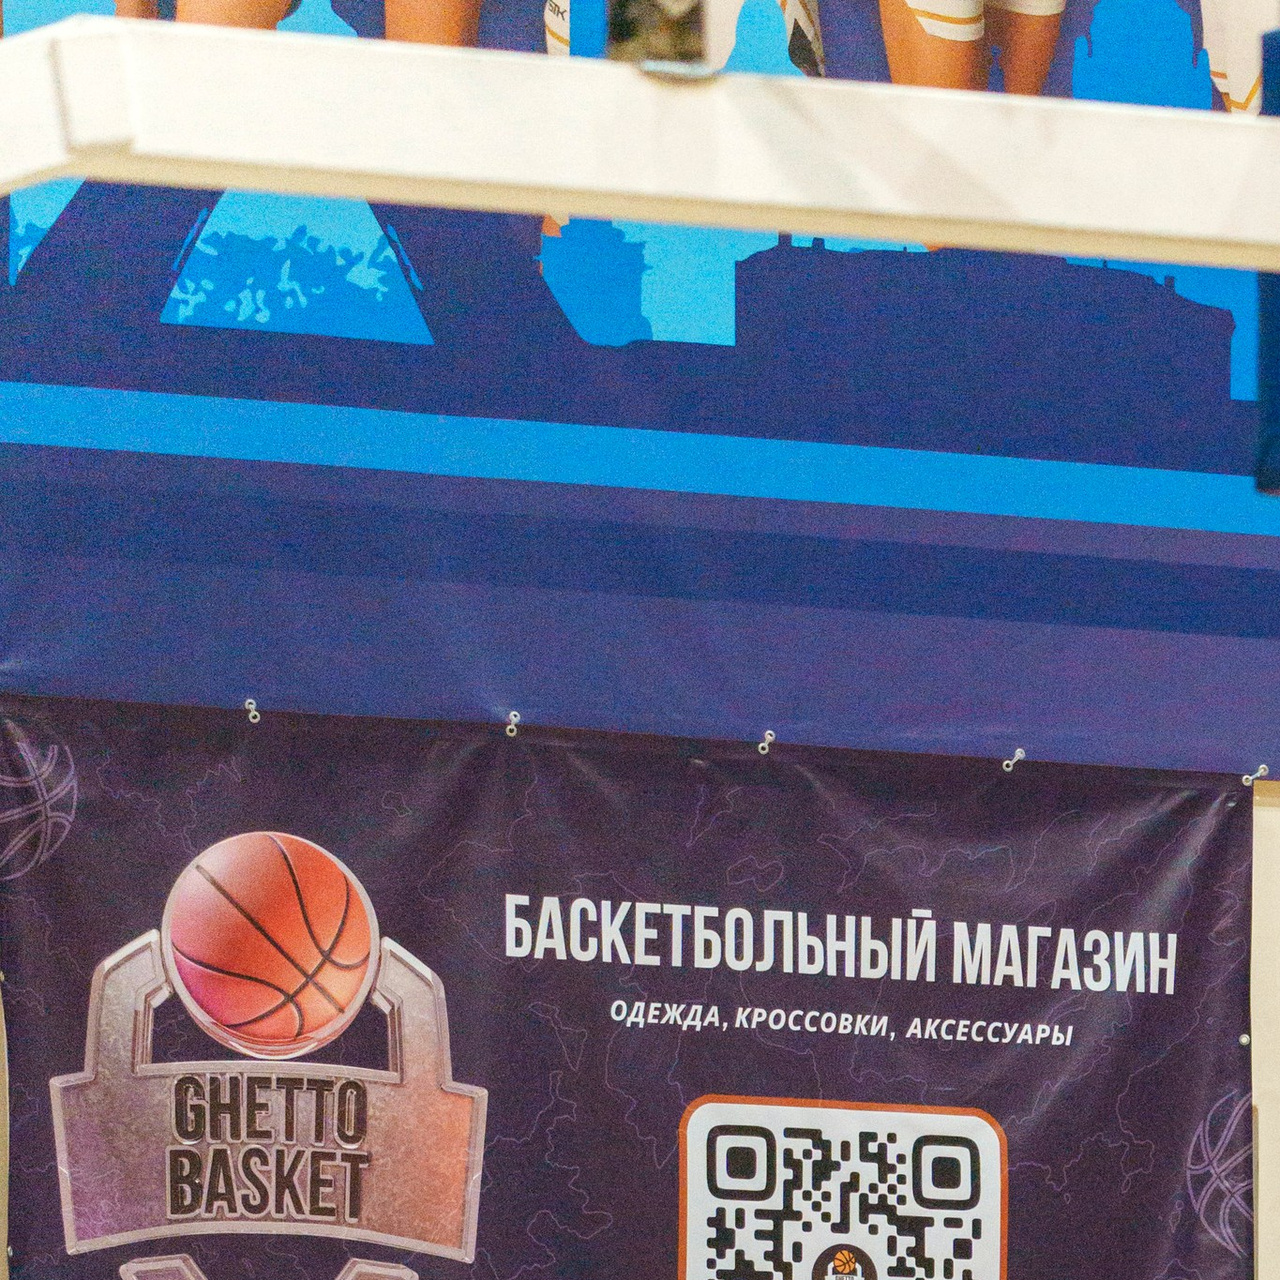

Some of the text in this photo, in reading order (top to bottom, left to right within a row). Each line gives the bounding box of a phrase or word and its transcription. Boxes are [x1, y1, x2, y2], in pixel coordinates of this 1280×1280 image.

[505, 893, 1178, 995] БАСКЕТБОЛЬНЫЙ МАГАЗИН
[610, 999, 1074, 1046] ОДЕЖДА, КРОССОВКИ, АКСЕССУАРЫ
[173, 1074, 369, 1147] GHETTO
[168, 1146, 373, 1222] BASKET
